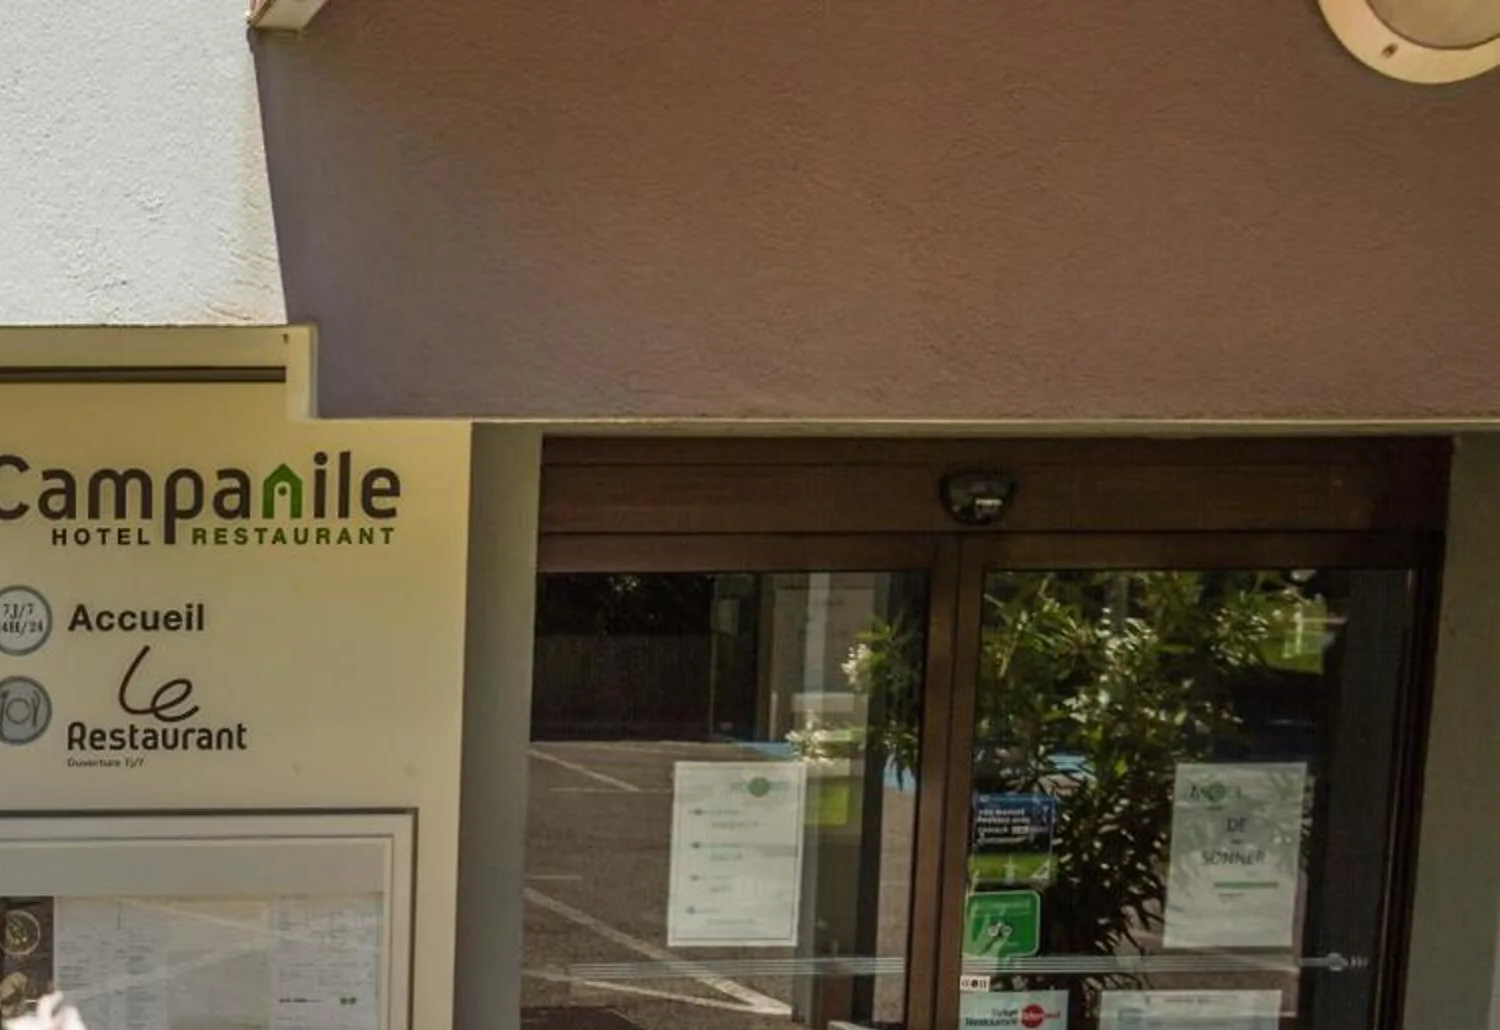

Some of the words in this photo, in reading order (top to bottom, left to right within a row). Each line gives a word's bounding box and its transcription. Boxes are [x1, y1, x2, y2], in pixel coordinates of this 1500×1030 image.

[52, 529, 151, 546] HOTEL
[192, 527, 395, 545] RESTAURANT
[68, 603, 205, 632] Accueil
[67, 722, 248, 752] Restaurant
[67, 758, 121, 767] Ouverture
